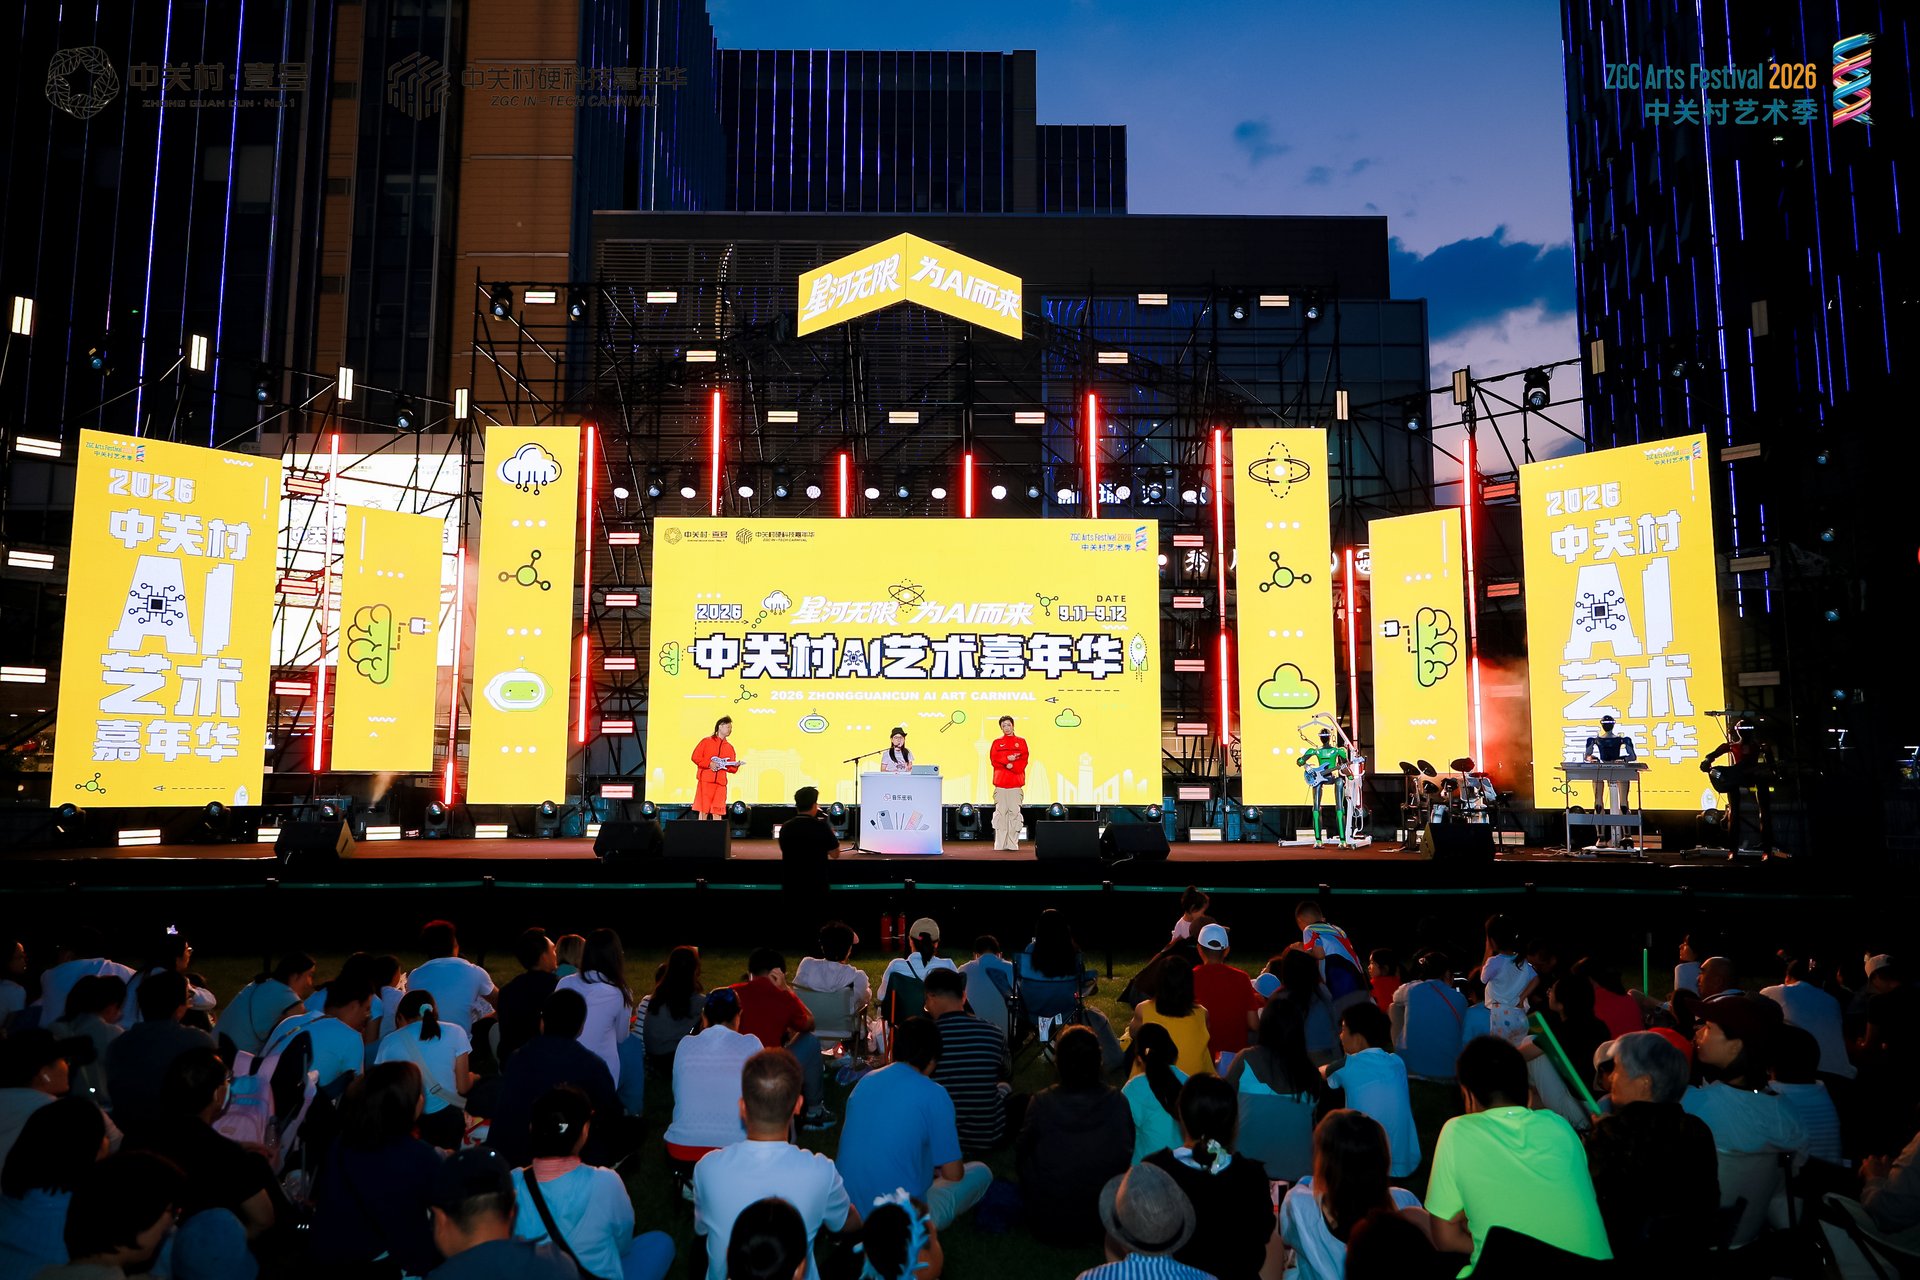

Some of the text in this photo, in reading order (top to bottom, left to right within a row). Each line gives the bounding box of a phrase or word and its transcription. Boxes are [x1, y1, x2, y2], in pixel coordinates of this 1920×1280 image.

[801, 253, 1020, 322] 星河无限 为AI而来
[108, 468, 196, 503] 2026
[1546, 481, 1621, 517] 2026
[109, 508, 251, 561] 中关村
[1551, 510, 1681, 564] 中关村
[108, 555, 234, 656] AI
[696, 603, 742, 620] 2026
[789, 595, 1035, 627] 星河无限 为AI而来
[1096, 595, 1127, 603] DATE
[1563, 556, 1674, 661] AI
[694, 632, 1124, 680] 中关村AI艺术嘉年华
[99, 651, 243, 717] 艺术
[770, 691, 1036, 701] 2026 ZHONGGUANCUN AI ART CARNIVAL
[1559, 654, 1694, 720] 艺术
[92, 719, 240, 763] 嘉年华
